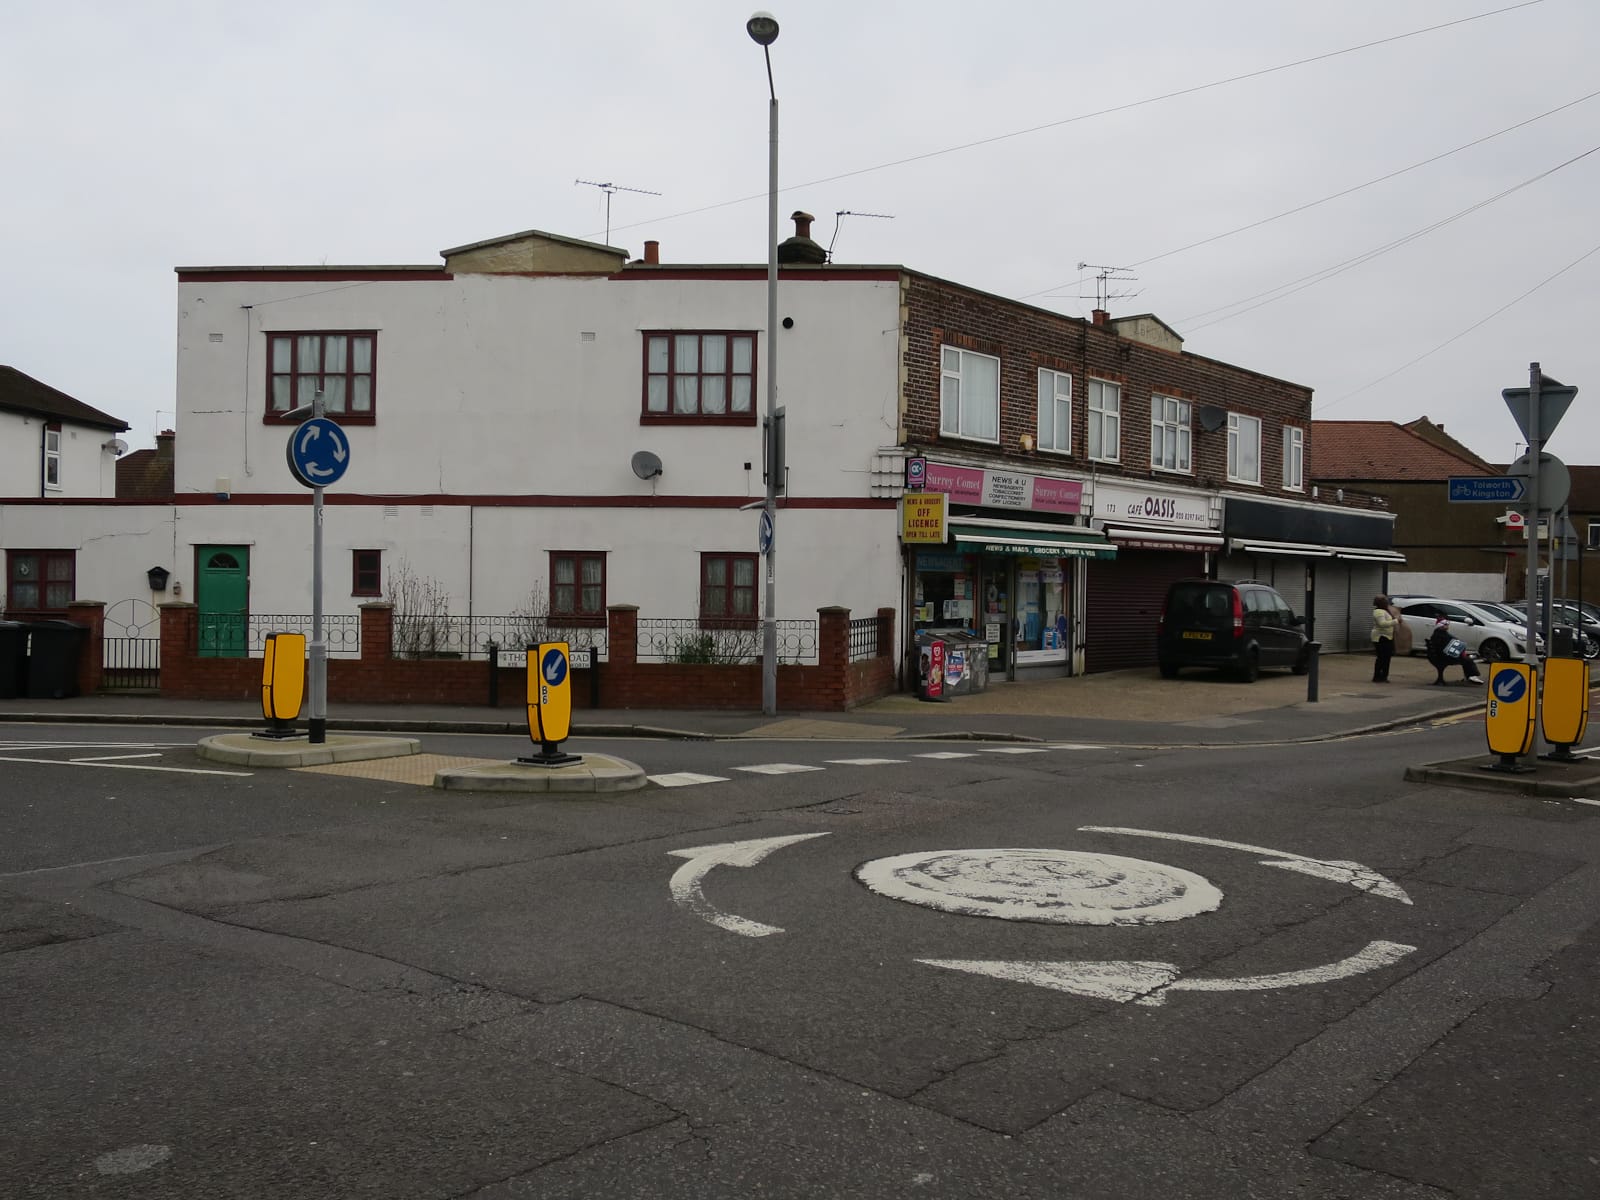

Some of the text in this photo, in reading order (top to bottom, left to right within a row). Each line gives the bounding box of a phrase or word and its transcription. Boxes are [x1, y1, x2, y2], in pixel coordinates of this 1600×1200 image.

[927, 472, 980, 489] Surrey Comet
[992, 476, 1013, 485] NEWS
[1473, 480, 1511, 489] Tolworth
[1035, 485, 1080, 499] Surrey Comet
[1472, 489, 1511, 498] Kingston
[988, 493, 1026, 501] CONFECTIONERY
[917, 508, 930, 517] OFF
[1144, 497, 1176, 519] OASIS
[908, 519, 939, 528] LICENCE
[570, 654, 590, 662] OAD
